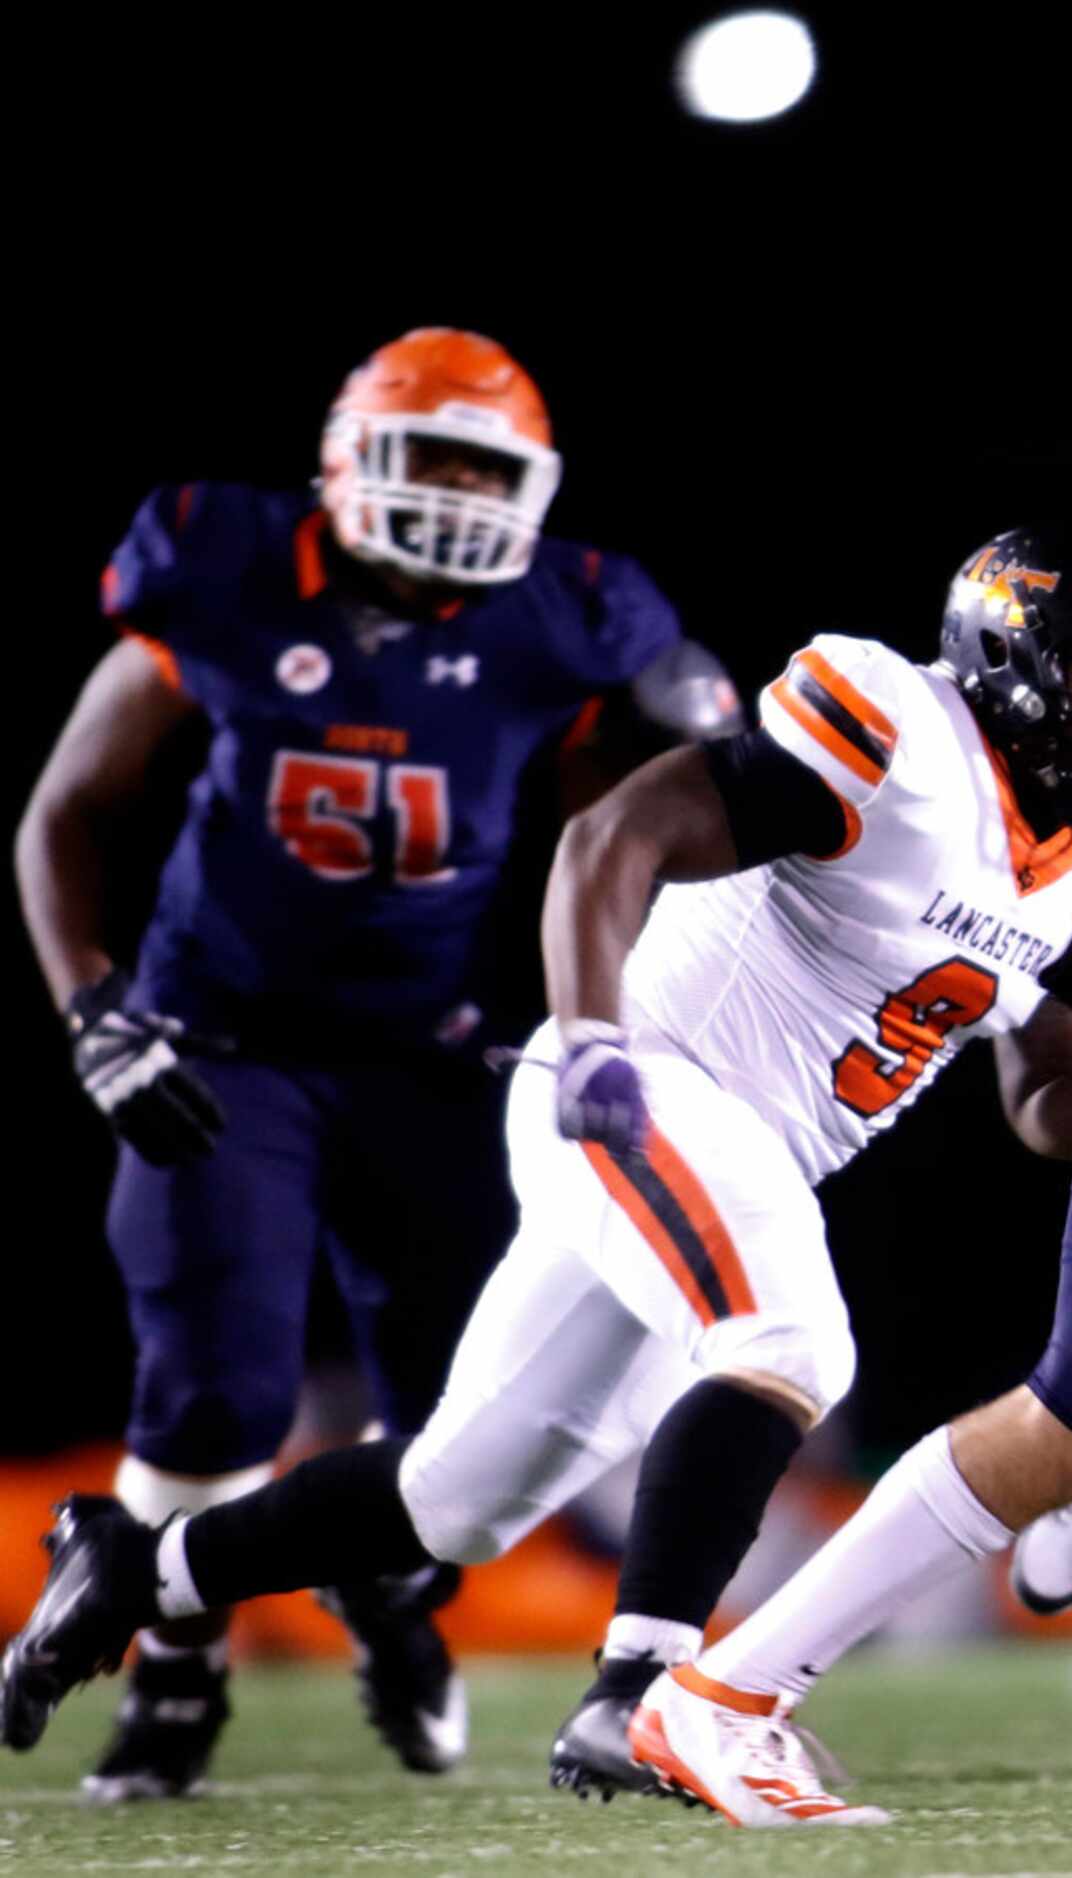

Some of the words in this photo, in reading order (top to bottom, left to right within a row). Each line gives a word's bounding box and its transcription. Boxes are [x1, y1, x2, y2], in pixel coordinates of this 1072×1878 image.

[267, 748, 458, 884] 51
[920, 890, 1054, 978] LANCASTER
[831, 954, 1000, 1121] 9
